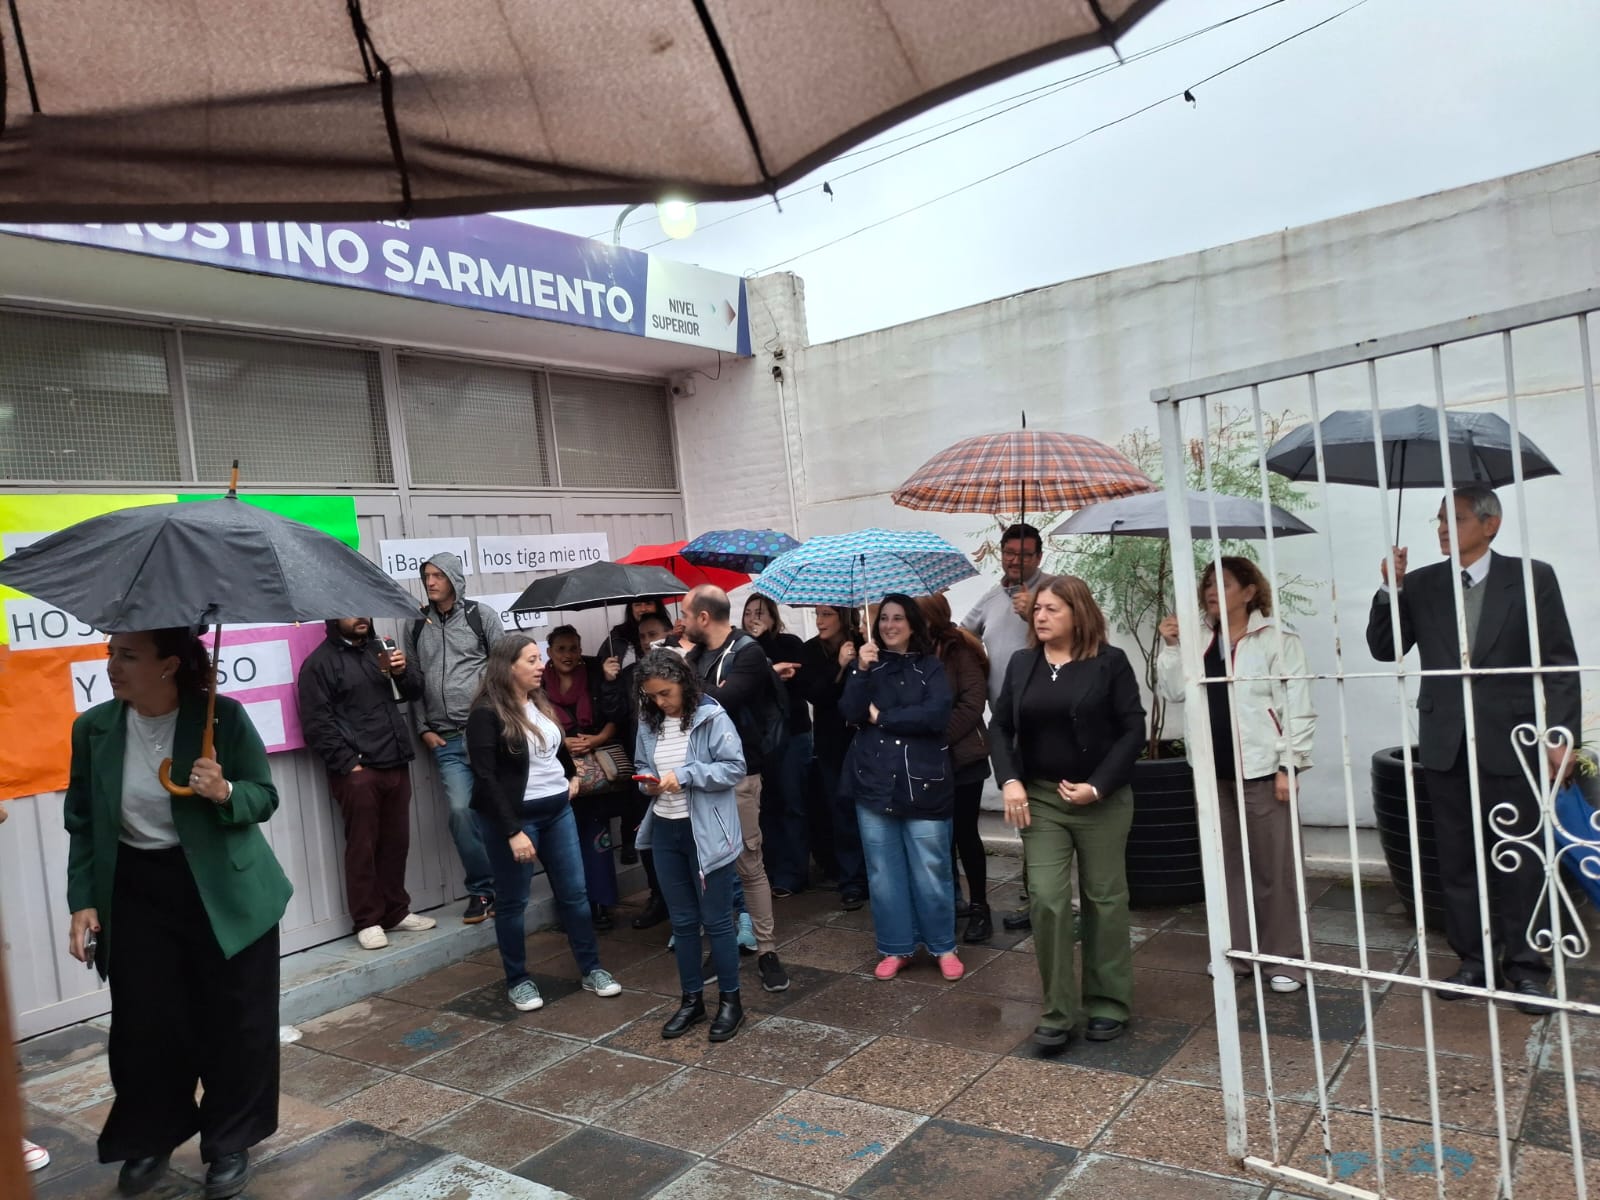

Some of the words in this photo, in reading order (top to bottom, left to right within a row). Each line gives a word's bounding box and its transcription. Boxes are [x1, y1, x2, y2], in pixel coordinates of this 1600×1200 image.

[383, 239, 634, 324] SARMIENTO
[669, 298, 698, 318] NIVEL
[652, 314, 701, 337] SUPERIOR
[75, 674, 97, 703] Y
